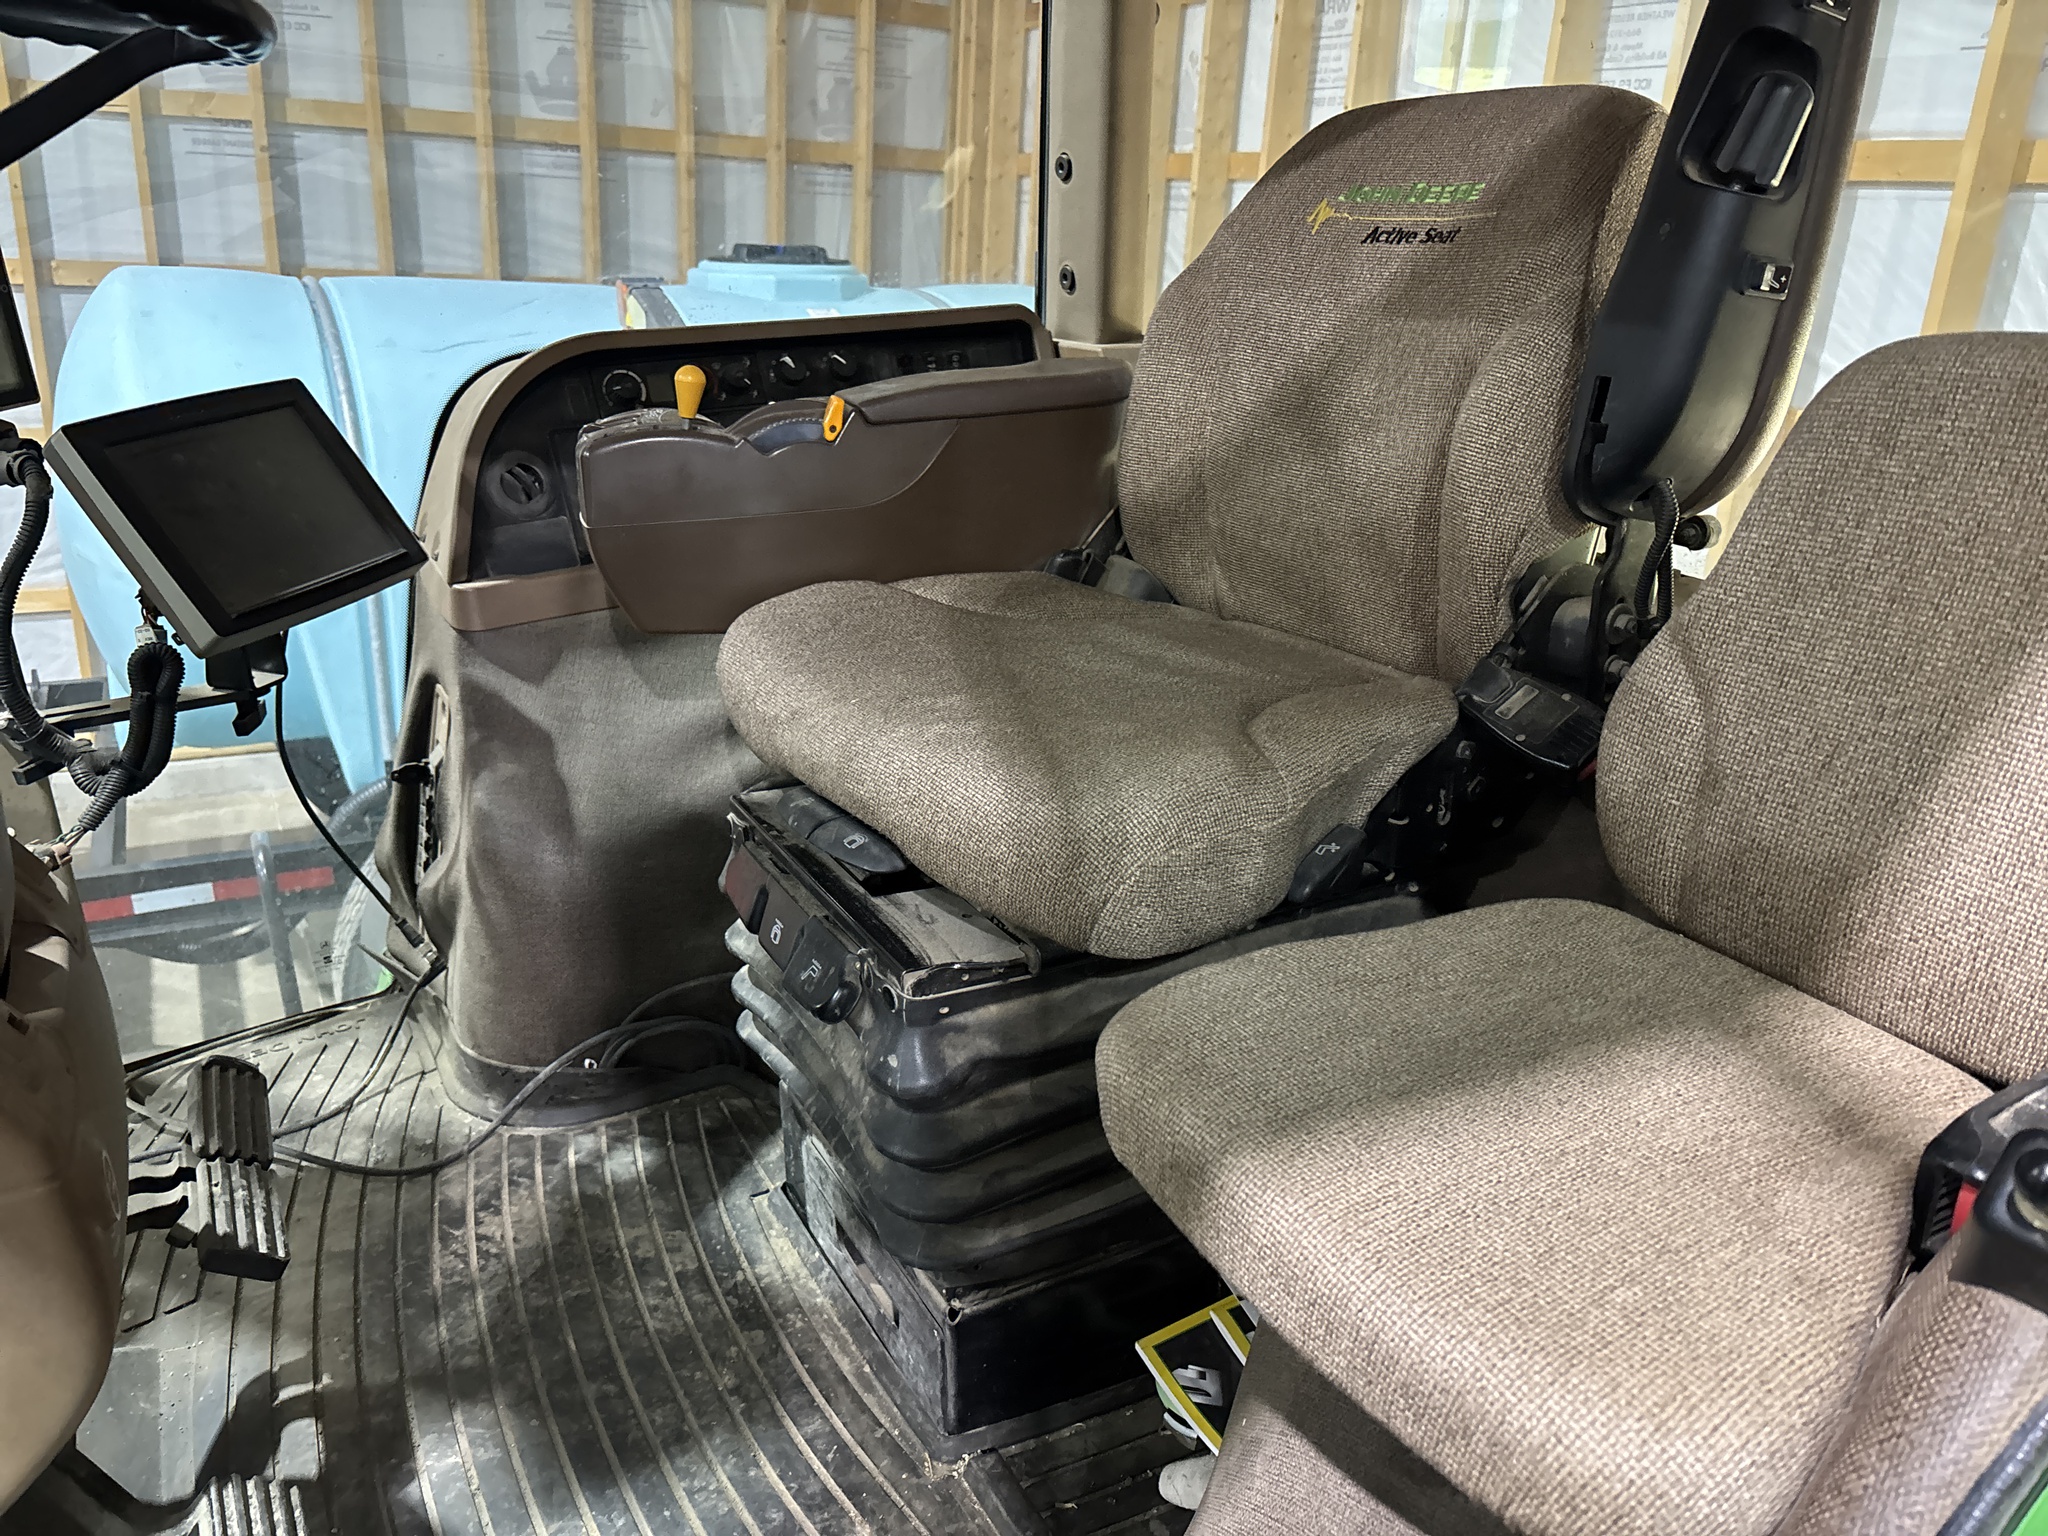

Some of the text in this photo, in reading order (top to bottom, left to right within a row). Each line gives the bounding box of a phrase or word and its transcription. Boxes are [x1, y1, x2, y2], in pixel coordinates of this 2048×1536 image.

[1337, 181, 1486, 204] JOHN DEERE
[1360, 225, 1463, 245] Active Seat
